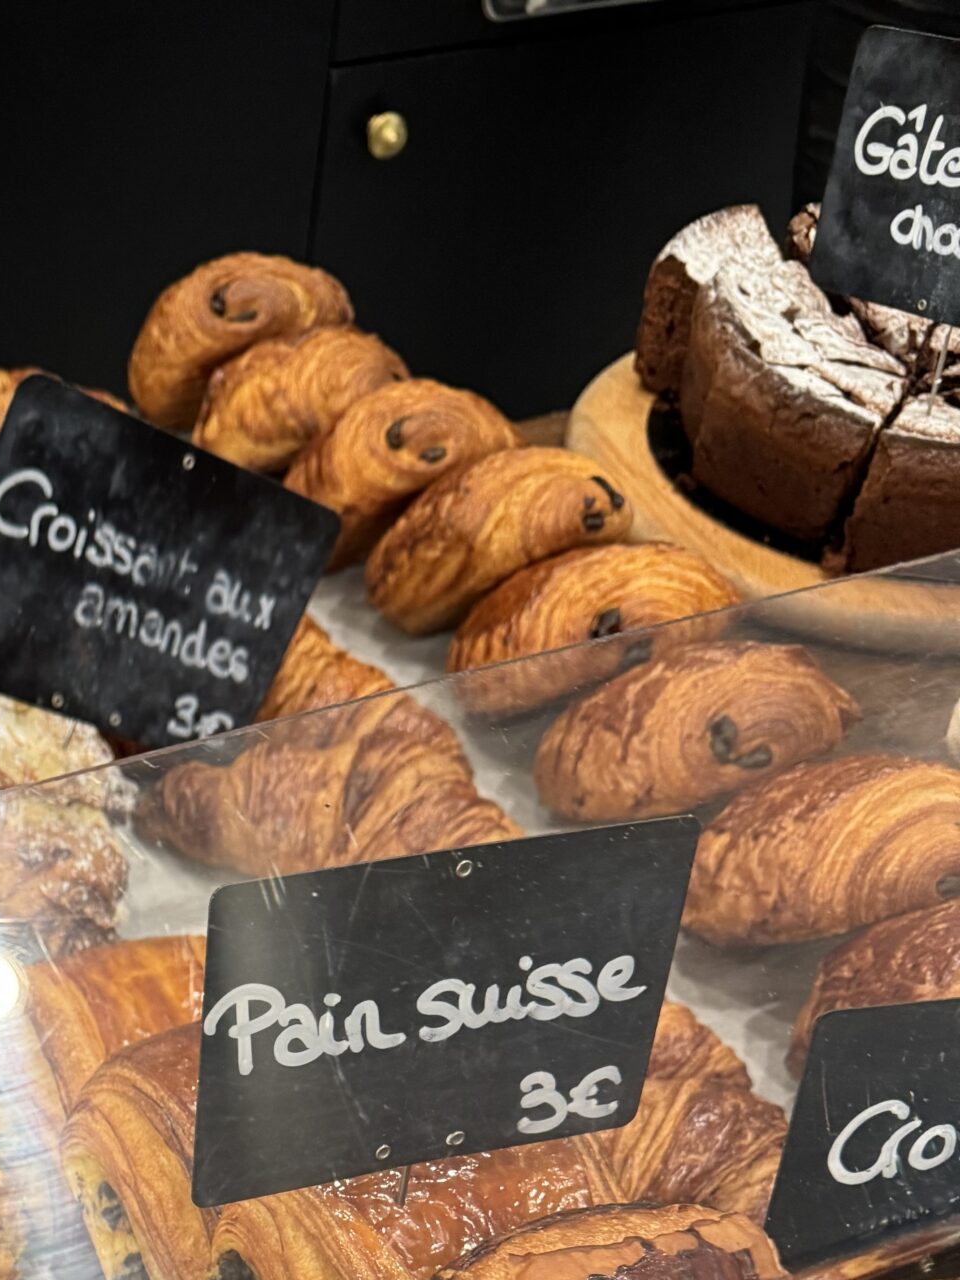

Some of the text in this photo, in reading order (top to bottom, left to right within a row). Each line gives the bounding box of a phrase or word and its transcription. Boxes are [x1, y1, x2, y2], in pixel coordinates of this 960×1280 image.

[890, 204, 960, 260] cho
[74, 584, 249, 683] amandes
[206, 570, 276, 630] aux
[204, 955, 646, 1075] Pain suisse
[517, 1065, 622, 1134] 3€
